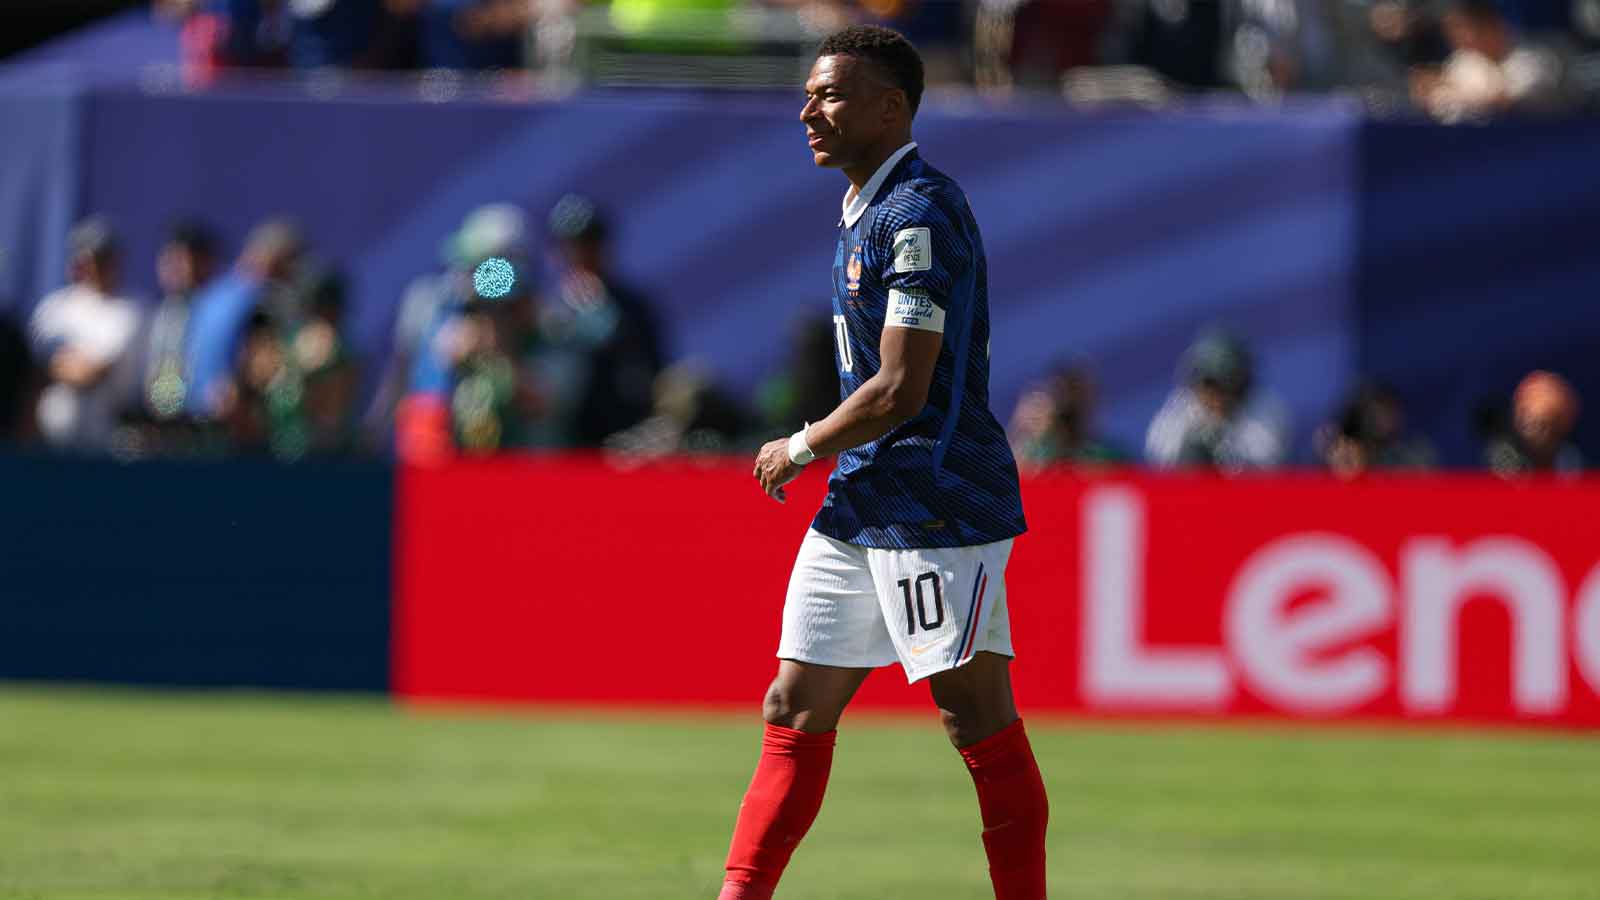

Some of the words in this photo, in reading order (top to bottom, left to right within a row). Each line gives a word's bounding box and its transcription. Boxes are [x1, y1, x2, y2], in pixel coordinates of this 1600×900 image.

[898, 295, 933, 308] UNITES
[907, 306, 934, 320] World
[834, 314, 853, 373] 10
[897, 571, 945, 636] 10
[1082, 484, 1600, 715] Len
